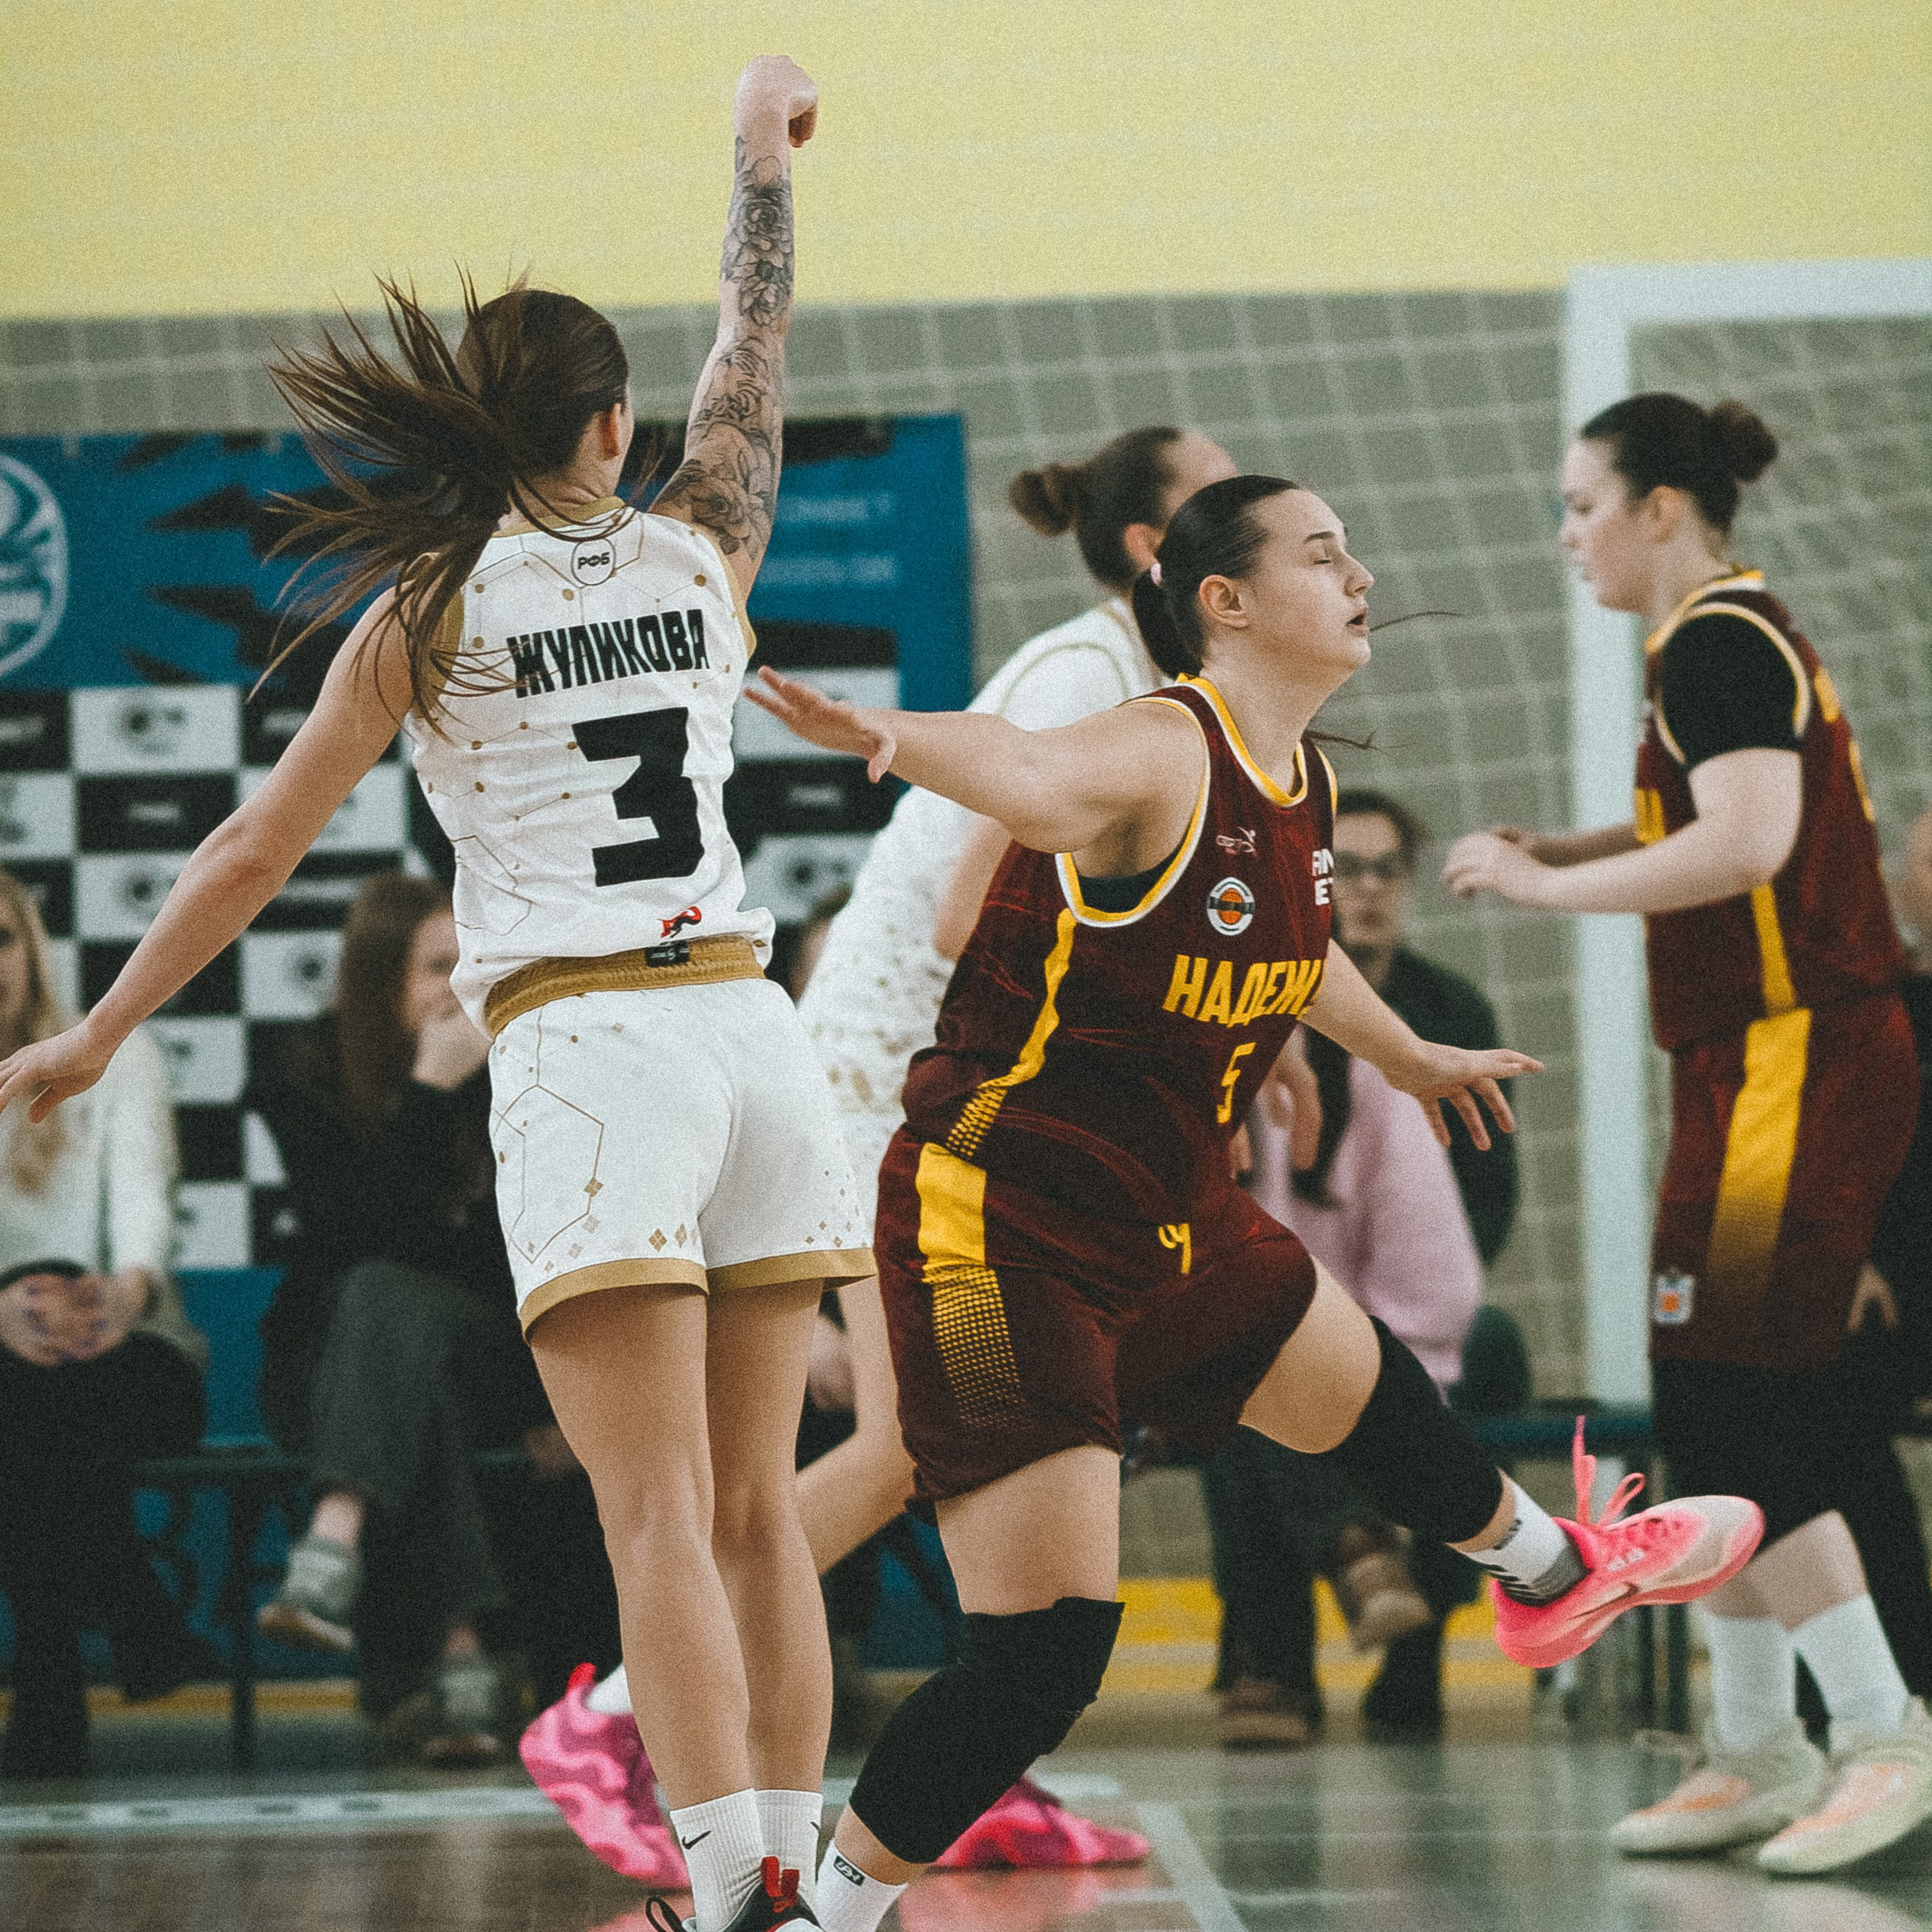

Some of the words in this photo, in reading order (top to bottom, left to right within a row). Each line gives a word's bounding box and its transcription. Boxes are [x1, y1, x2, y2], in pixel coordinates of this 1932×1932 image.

[506, 608, 710, 699] ЖУЛИКОВА
[571, 706, 705, 888] 3
[1161, 953, 1326, 1028] НАДЕЖ
[1216, 1041, 1257, 1124] 5
